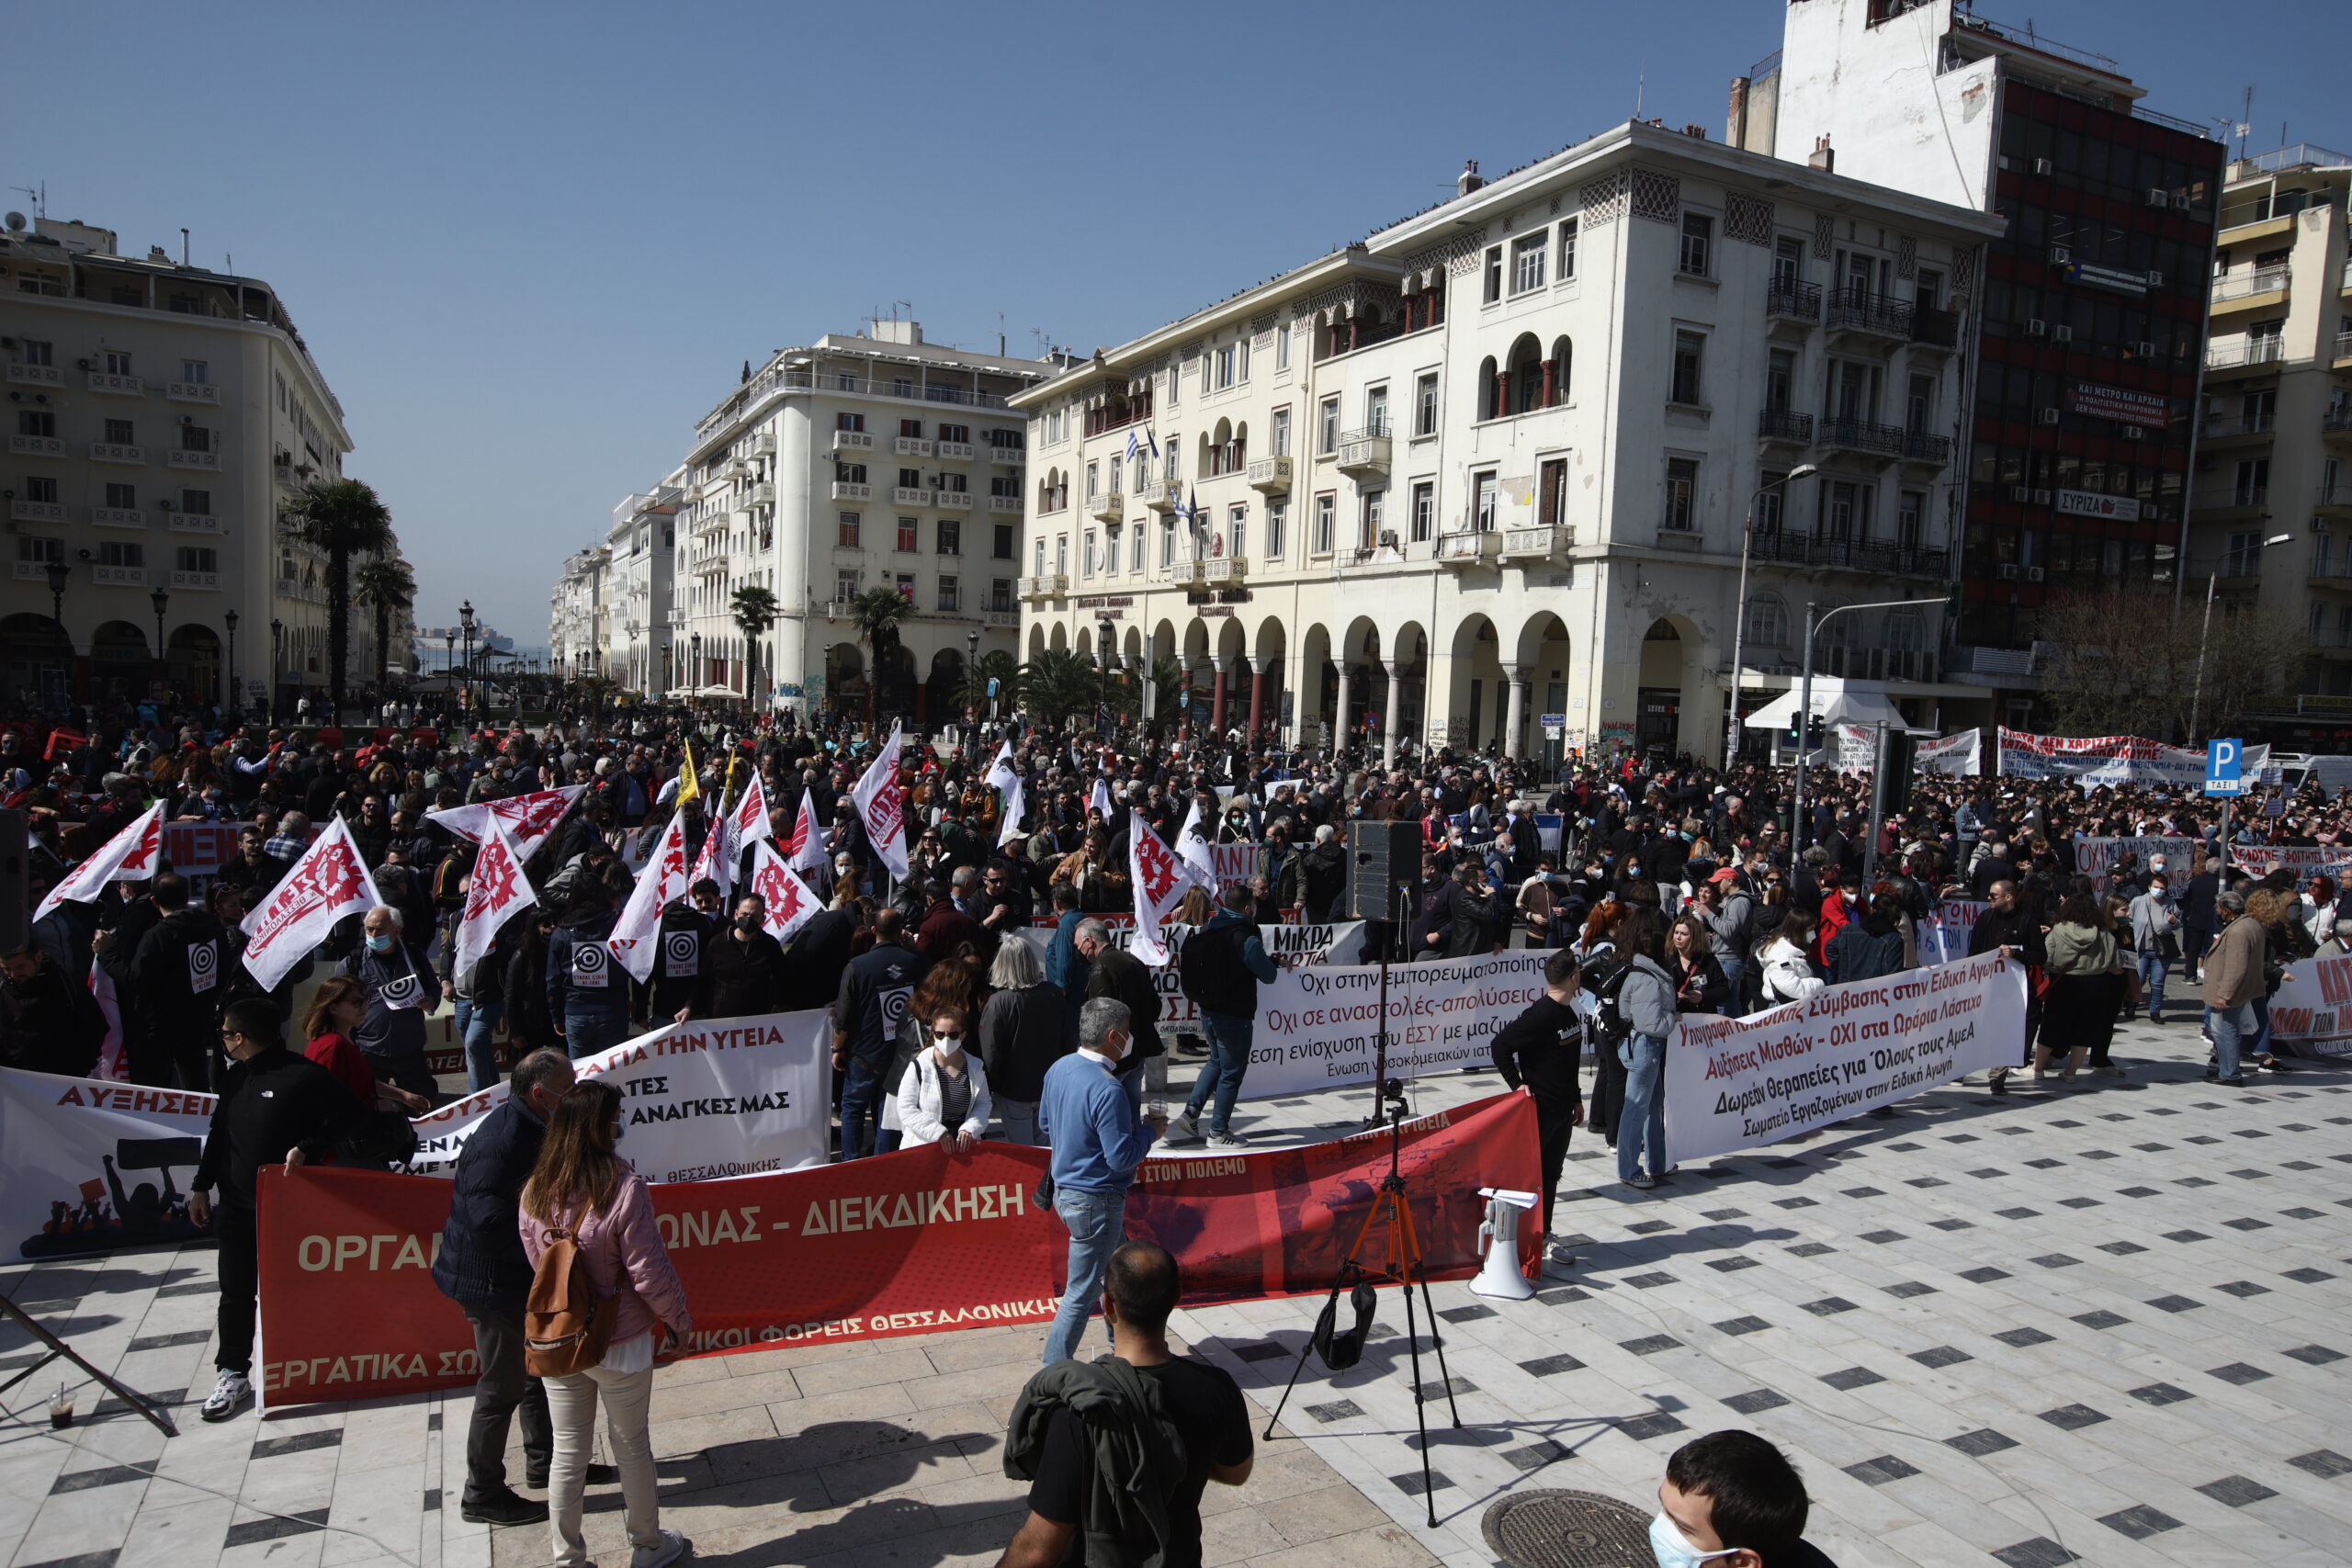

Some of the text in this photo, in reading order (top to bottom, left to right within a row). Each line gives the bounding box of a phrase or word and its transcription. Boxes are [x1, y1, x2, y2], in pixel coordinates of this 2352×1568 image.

[2075, 403, 2088, 412] ΔΕΝ
[2078, 384, 2165, 407] ΚΑΙ ΜΕΤΡΟ ΚΑΙ ΑΡΧΑΙΑ
[2062, 493, 2100, 513] ΣΥΡΙΖΑ
[2041, 737, 2064, 748] ΔΕΝ
[2214, 742, 2233, 777] P
[2211, 781, 2232, 789] ΤΑΞΙ
[2078, 842, 2106, 873] ΟΧΙ
[1273, 926, 1334, 952] ΜΙΚΡΑ
[1298, 954, 1549, 996] Όχι στην εμπορευματοποίησ
[1808, 987, 1889, 1019] Σύμβασης
[1893, 979, 1929, 1004] στην
[1929, 969, 1967, 994] Ειδική
[1969, 953, 2007, 987] Αγωγή
[1266, 1009, 1298, 1035] Όχι
[1303, 1009, 1325, 1026] σε
[1704, 1049, 1759, 1082] Αυξήσεις
[1758, 1032, 1815, 1064] Μισθών
[1830, 1021, 1858, 1047] ΟΧΙ
[1860, 1017, 1890, 1041] στα
[1894, 1007, 1938, 1039] Ωράρια
[1939, 993, 1983, 1021] Λάστιχο
[607, 1045, 649, 1071] ΓΙΑ
[652, 1032, 707, 1056] ΤΗΝ
[711, 1025, 785, 1051] ΥΓΕΙΑ
[1249, 1045, 1284, 1066] εση
[1289, 1035, 1366, 1064] ενίσχυση
[1406, 1024, 1440, 1044] ΕΣΥ
[1442, 1023, 1463, 1044] με
[1326, 1060, 1369, 1078] Ένωση
[1713, 1021, 1975, 1117] Δωρεάν Θεραπείες για Όλους τους ΑμεΑ
[629, 1091, 789, 1126] ΑΝΑΓΚΕΣ ΜΑΣ
[1742, 1056, 1954, 1138] Σωματείο Εργαζομένων στην Ειδική Αγωγή
[414, 1137, 447, 1153] ΕΝ
[667, 1158, 782, 1184] ΘΕΣΣΑΛΟΝΙΚΗΣ
[1145, 1157, 1247, 1183] ΣΤΟΝ ΠΟΛΕΜΟ
[658, 1206, 762, 1249] ΩΝΑΣ
[800, 1183, 1025, 1237] ΔΙΕΚΔΙΚΗΣΗ
[263, 1353, 429, 1392] ΕΡΓΑΤΙΚΑ
[759, 1317, 865, 1343] ΦΟΡΕΙΣ
[871, 1297, 1063, 1331] ΘΕΣΣΑΛΟΝΙΚΗΣ
